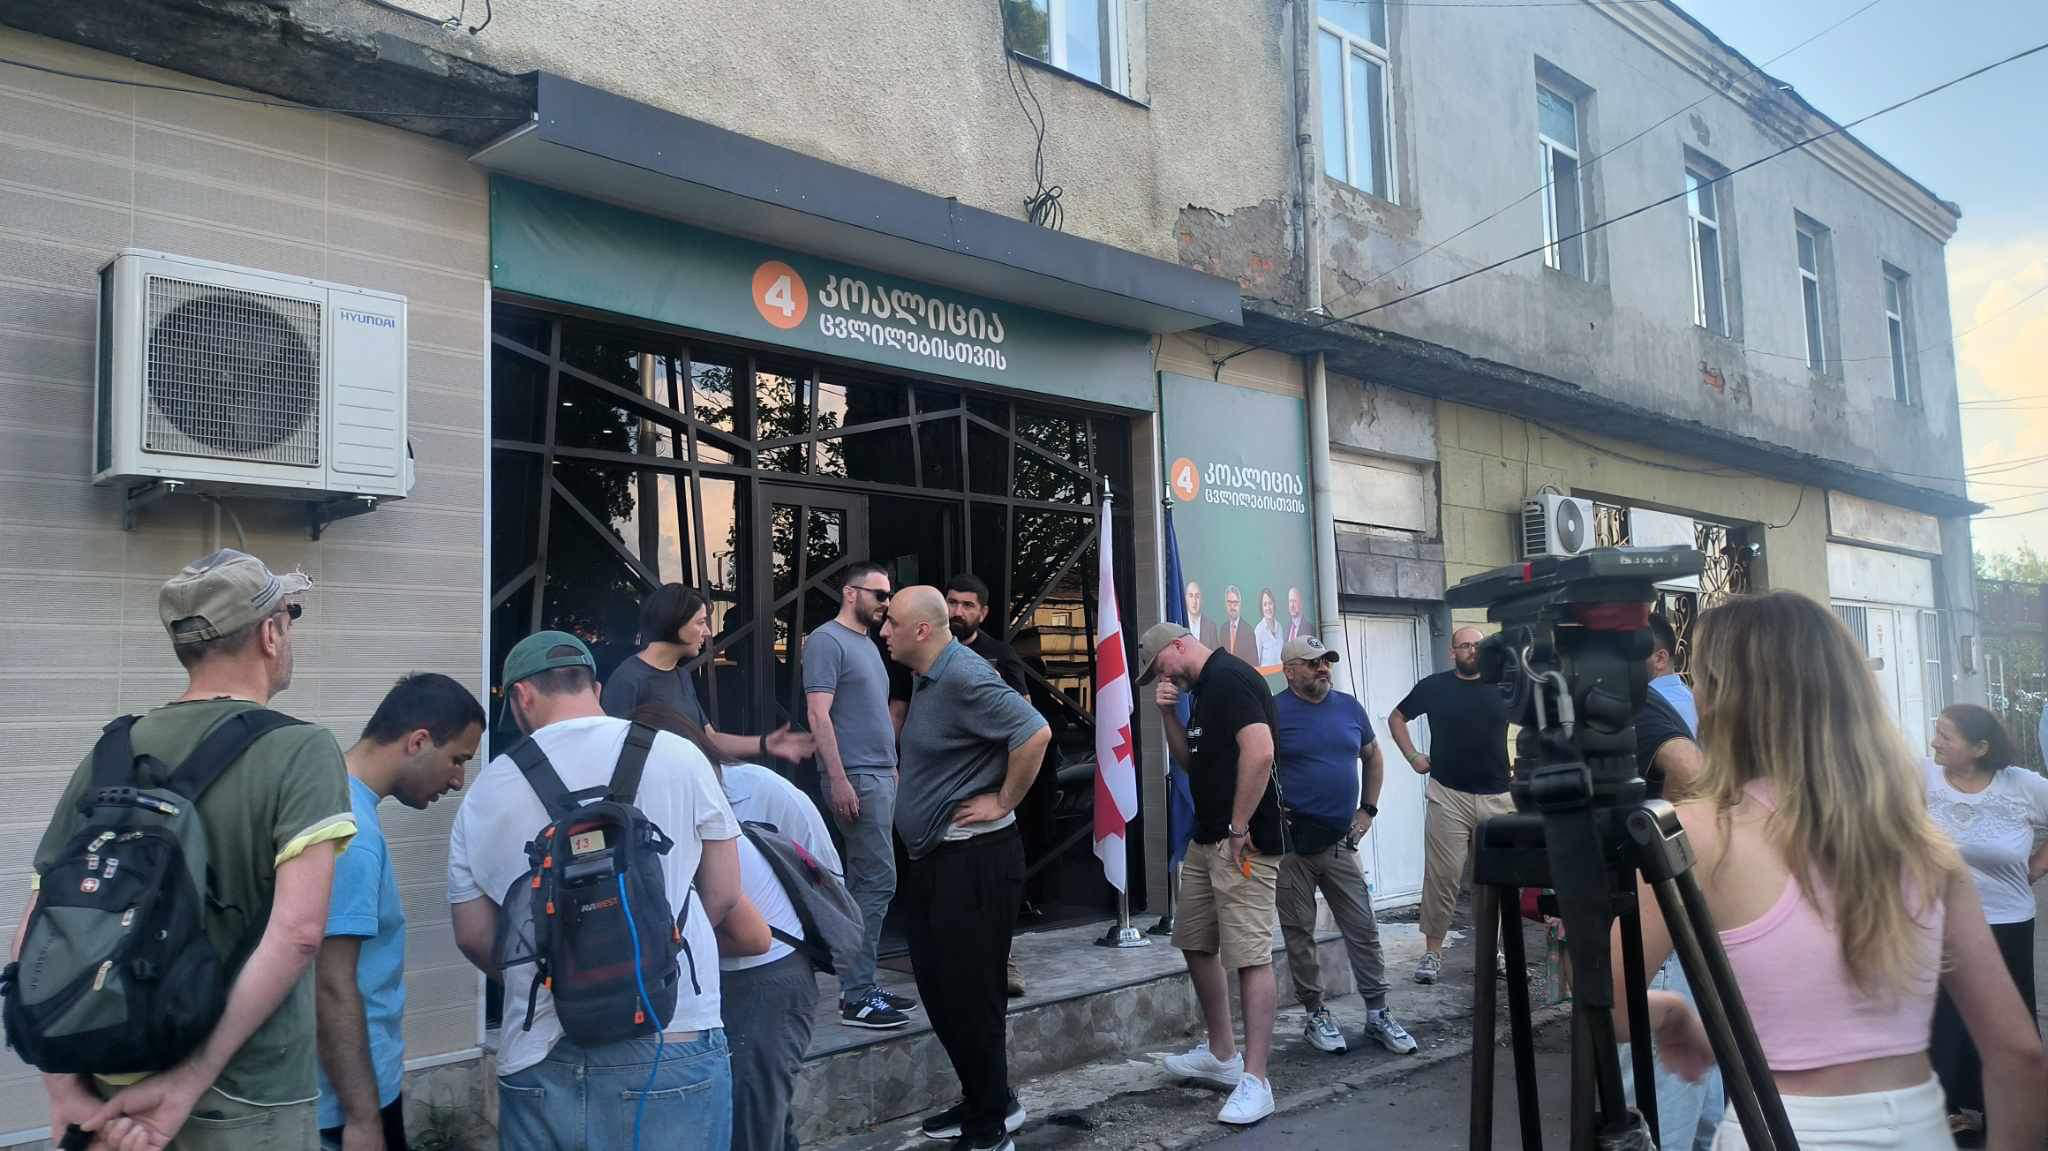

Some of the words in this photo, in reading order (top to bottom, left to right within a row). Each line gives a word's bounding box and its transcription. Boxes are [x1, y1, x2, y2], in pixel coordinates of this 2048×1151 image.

[765, 275, 796, 317] 4
[818, 274, 1005, 344] კოალიცია
[341, 311, 395, 328] HYUNDAI
[819, 312, 1007, 370] ცვლილებისთვის
[1178, 466, 1193, 493] 4
[1205, 462, 1303, 495] კოალიცია
[1205, 488, 1305, 514] ცვლილებისთვის
